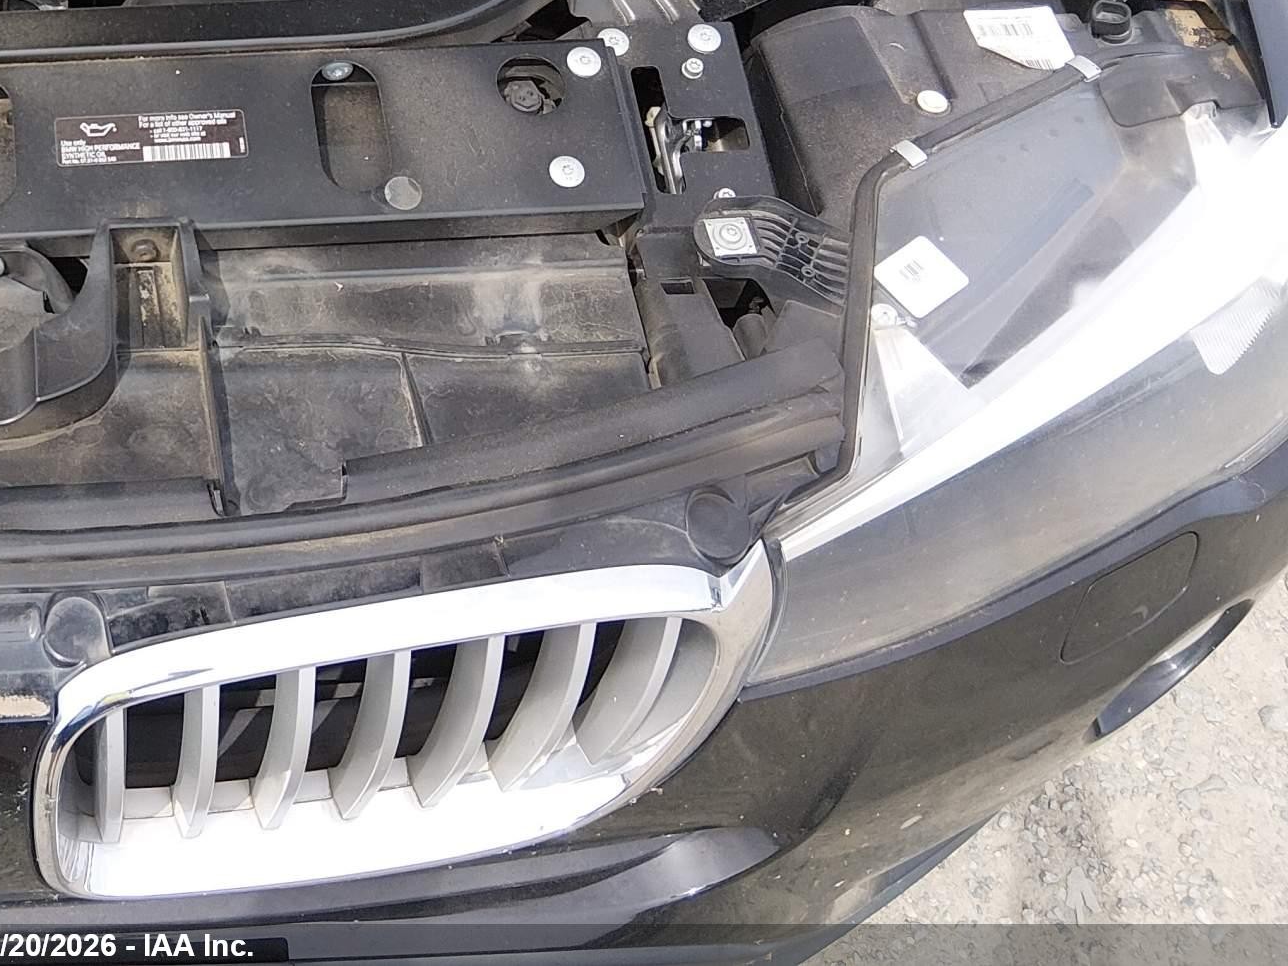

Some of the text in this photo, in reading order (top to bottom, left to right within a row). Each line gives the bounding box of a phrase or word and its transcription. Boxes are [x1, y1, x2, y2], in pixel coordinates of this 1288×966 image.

[189, 112, 213, 120] Owner's
[213, 111, 236, 119] Manual
[94, 142, 141, 151] PERFORMANCE
